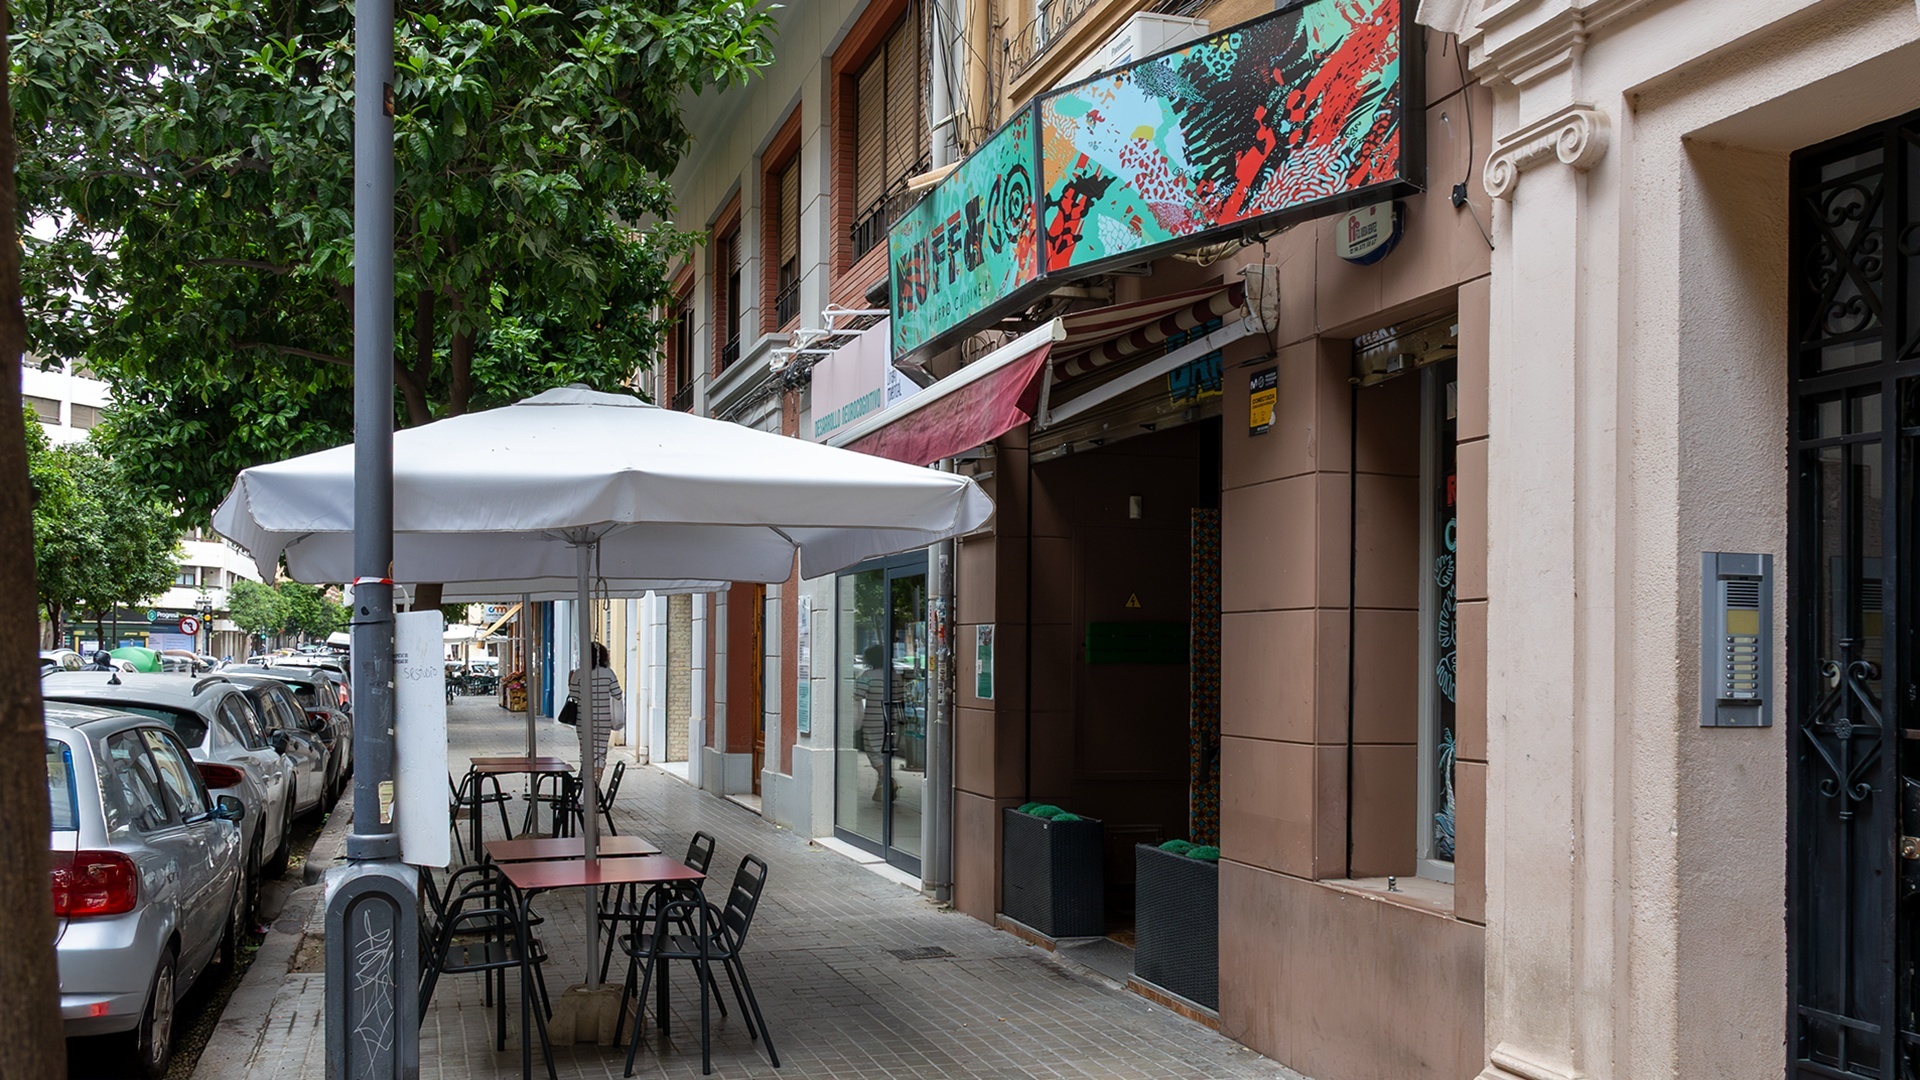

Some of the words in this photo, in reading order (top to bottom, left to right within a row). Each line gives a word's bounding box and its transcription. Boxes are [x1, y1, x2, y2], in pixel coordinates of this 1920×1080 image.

[934, 302, 951, 324] AFRO
[954, 283, 982, 311] CUISINE
[815, 408, 841, 438] DESARROLLO
